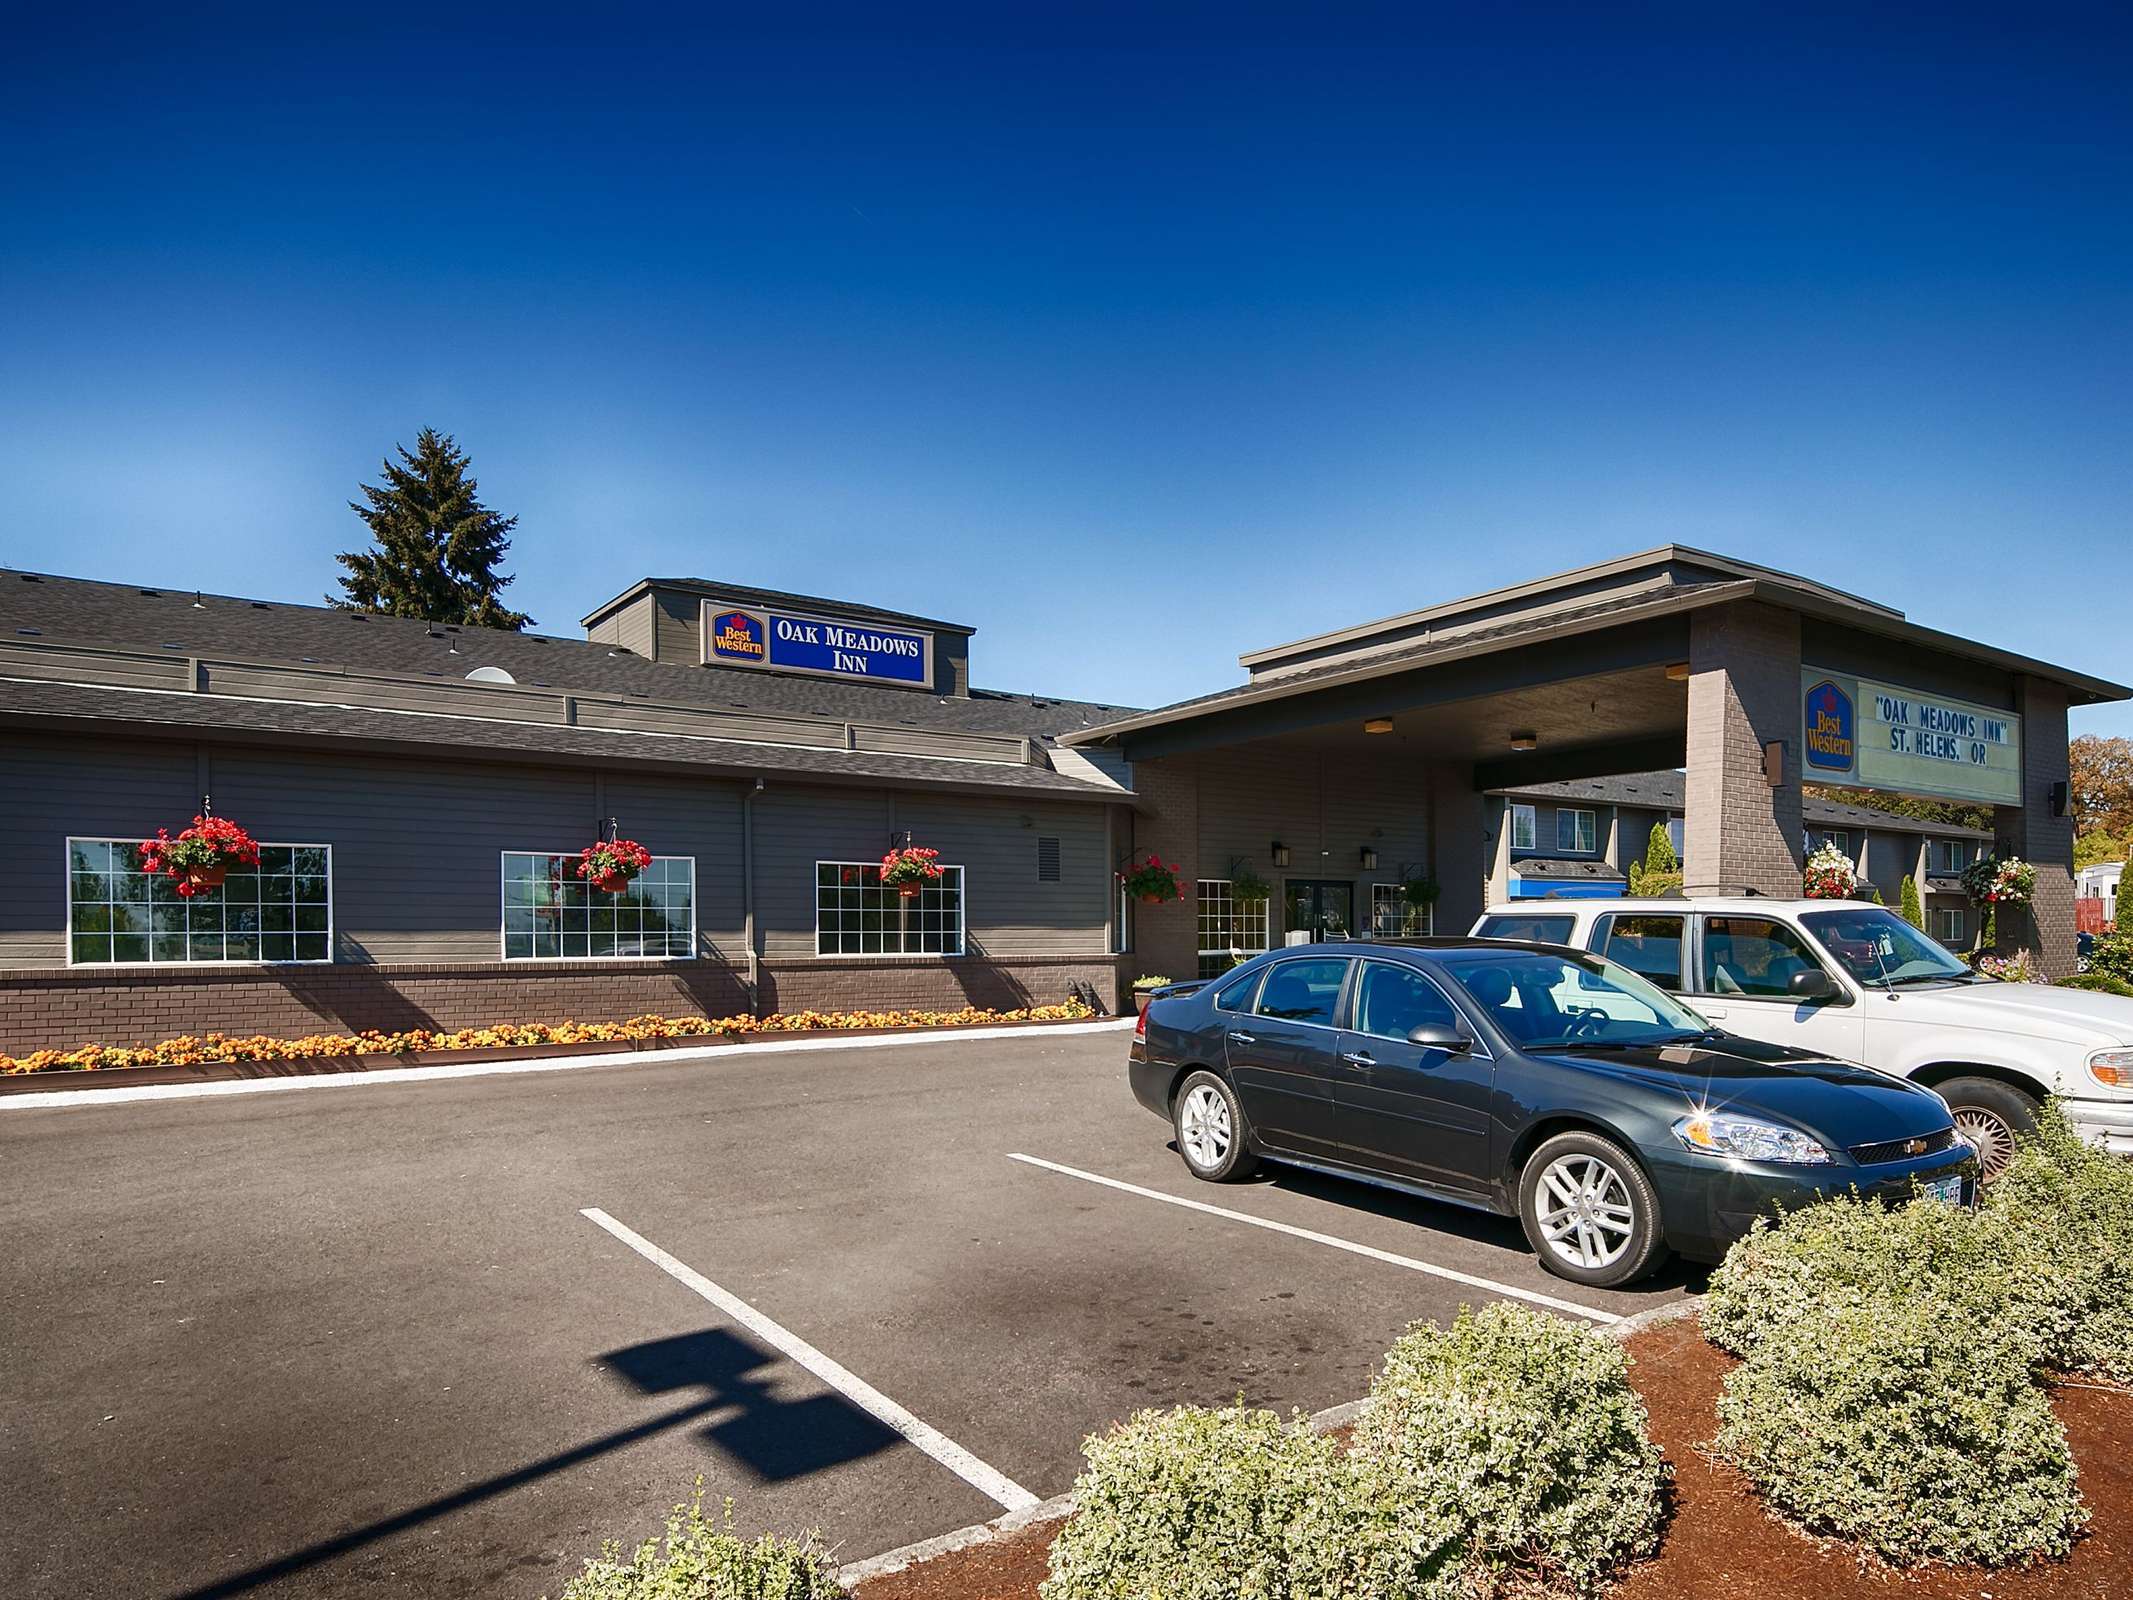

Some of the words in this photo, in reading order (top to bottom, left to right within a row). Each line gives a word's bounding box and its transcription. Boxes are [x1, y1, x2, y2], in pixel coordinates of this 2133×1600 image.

[715, 635, 762, 653] Western
[725, 626, 751, 641] Best
[777, 620, 819, 644] OAK
[825, 626, 919, 657] MEADOWS
[833, 650, 867, 672] INN
[1816, 710, 1841, 735] Best
[1920, 705, 1976, 737] MEADOWS
[1808, 728, 1852, 755] Western
[1891, 727, 1910, 752] ST.
[1916, 731, 1960, 761] HELENS.
[1971, 742, 1986, 765] OR
